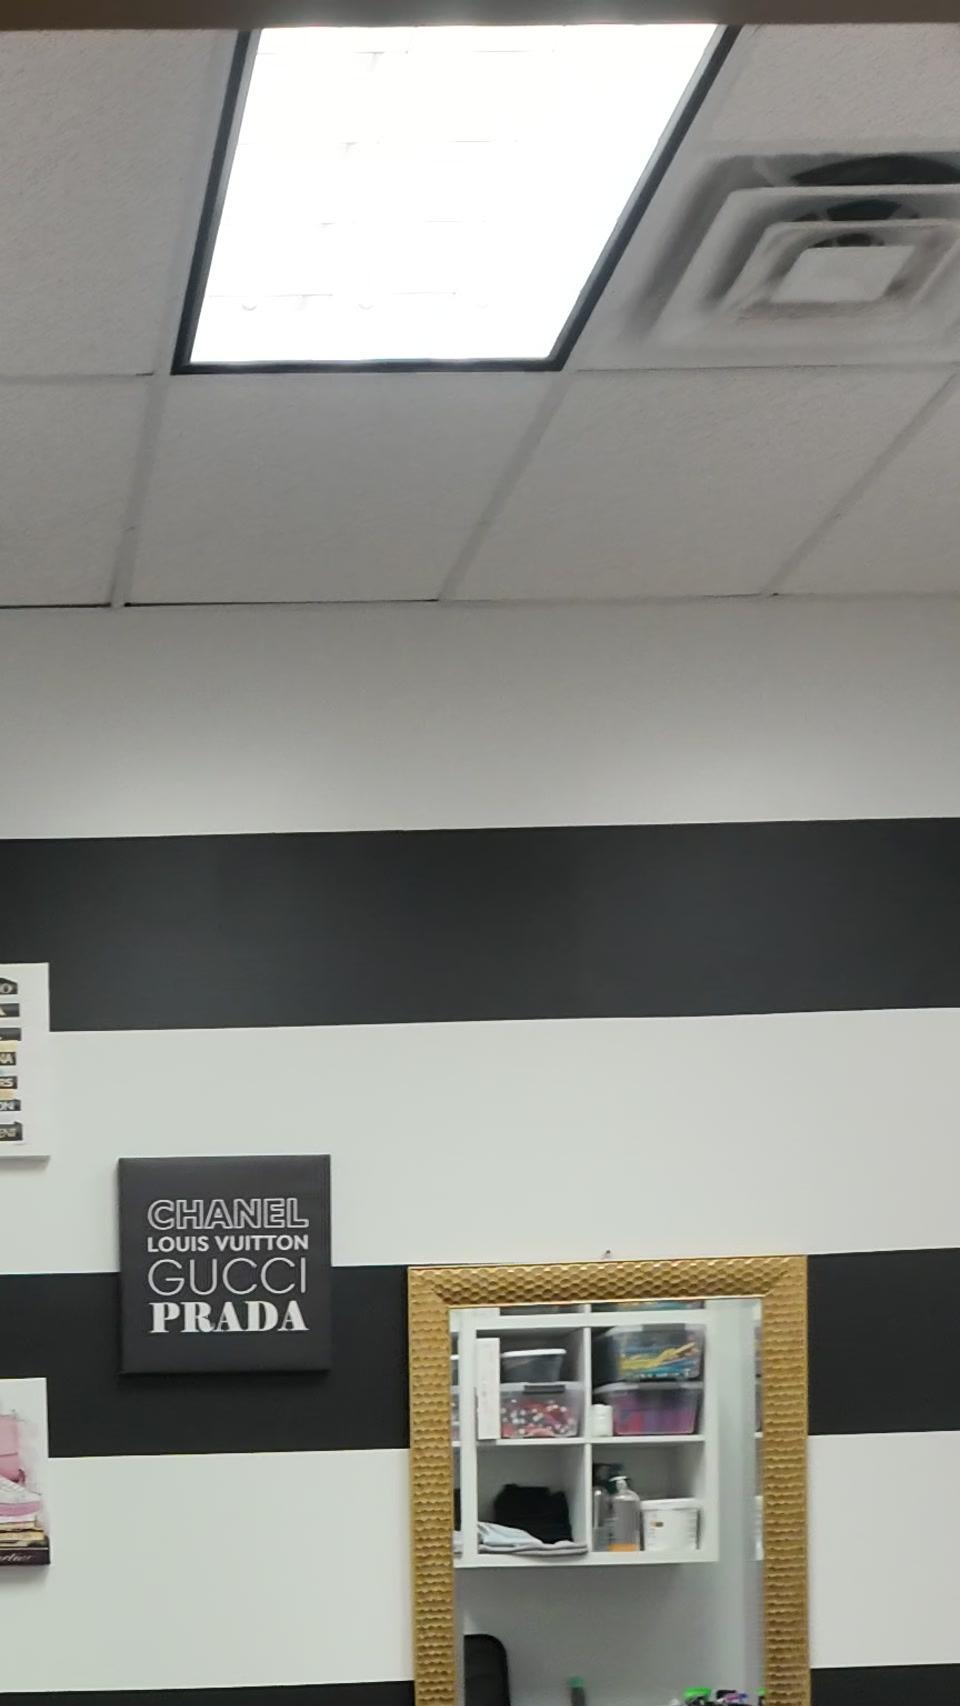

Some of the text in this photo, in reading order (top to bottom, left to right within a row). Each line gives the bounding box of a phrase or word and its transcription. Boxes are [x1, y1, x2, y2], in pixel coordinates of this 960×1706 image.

[147, 1198, 309, 1231] CHANEL
[147, 1234, 309, 1253] LOUIS VUITTON
[148, 1257, 306, 1296] GUCCI
[148, 1300, 310, 1333] PRADA
